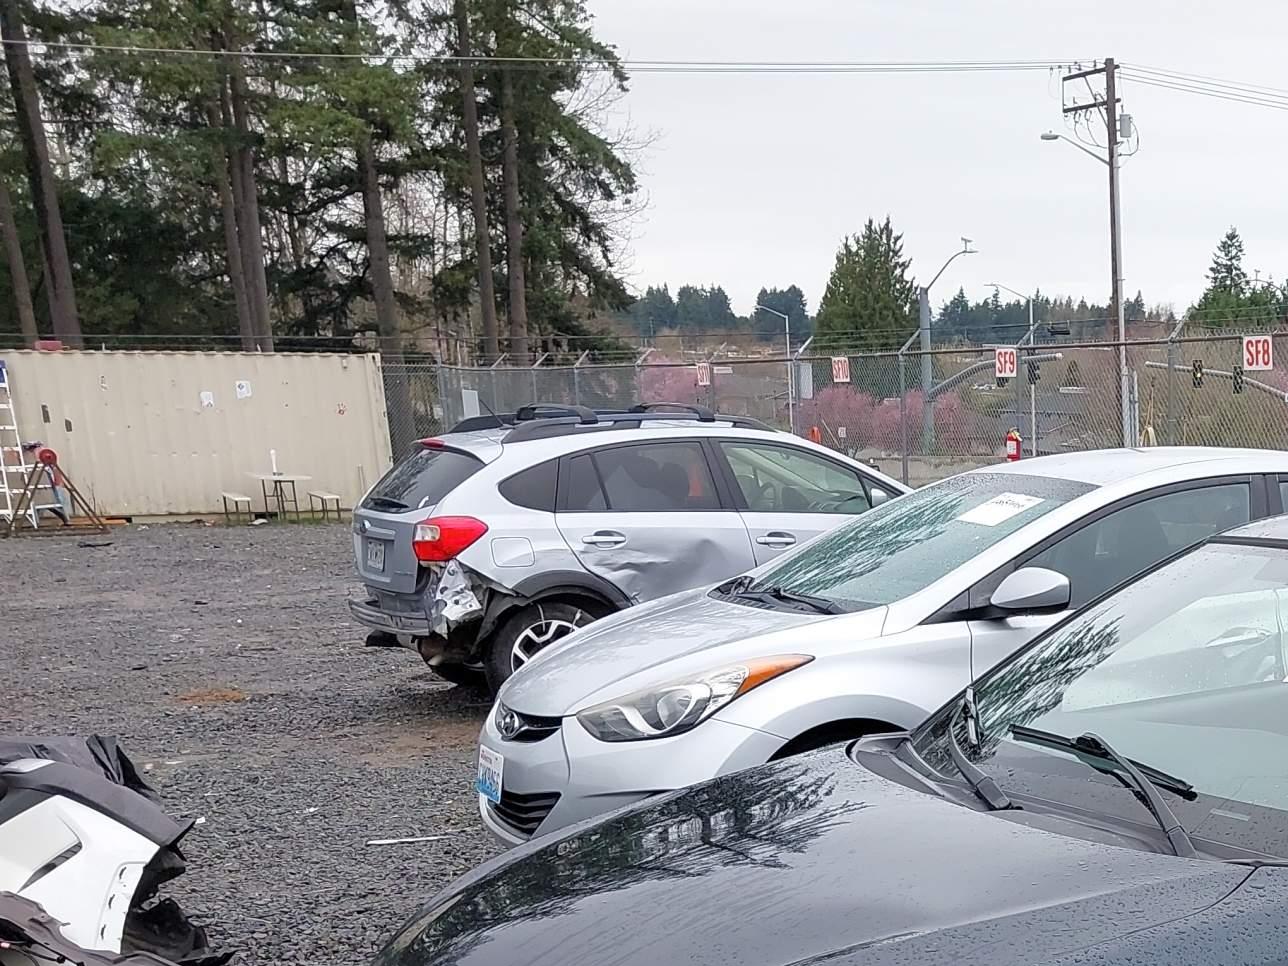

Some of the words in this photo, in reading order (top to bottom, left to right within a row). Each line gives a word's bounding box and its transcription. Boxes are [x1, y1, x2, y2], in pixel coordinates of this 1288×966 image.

[997, 350, 1015, 374] SF9
[1246, 339, 1270, 366] SF8
[833, 360, 849, 379] SF10
